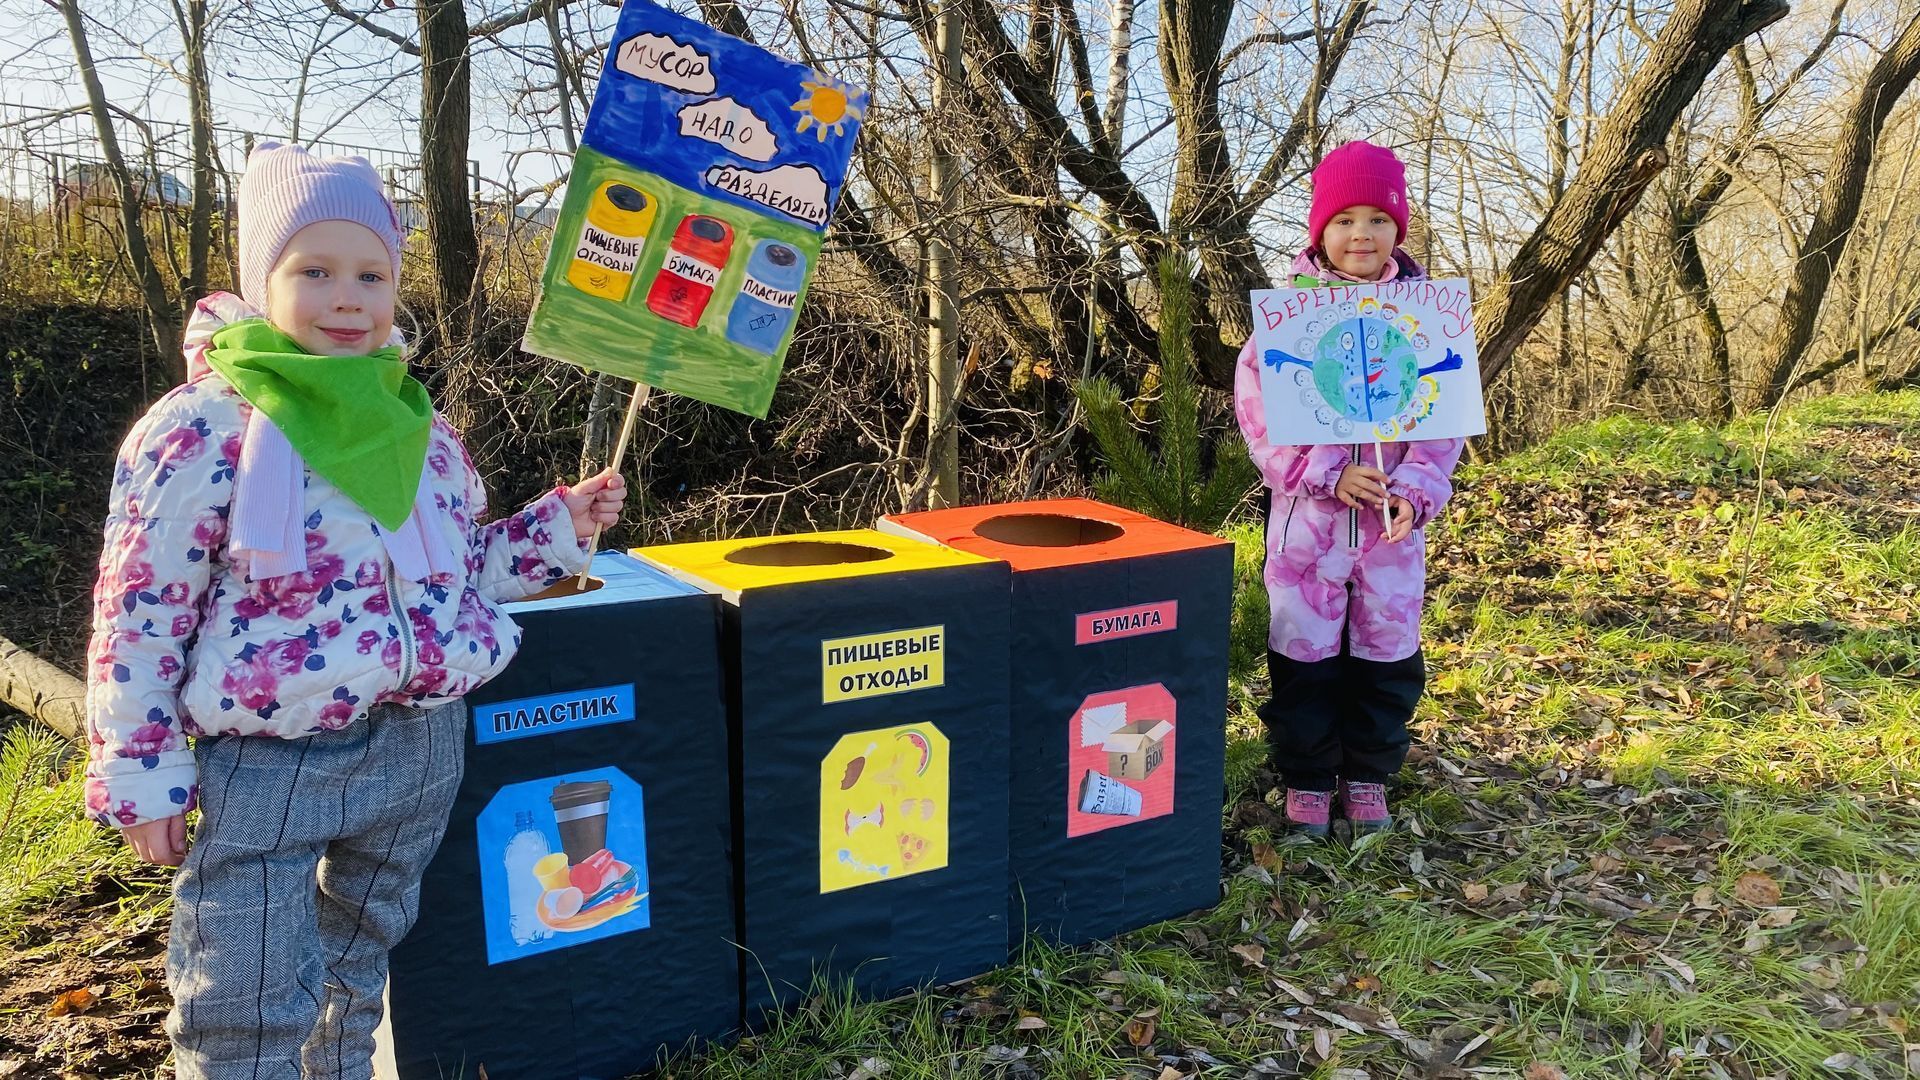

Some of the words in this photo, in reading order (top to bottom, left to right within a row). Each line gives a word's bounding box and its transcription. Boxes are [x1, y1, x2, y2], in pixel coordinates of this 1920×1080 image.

[626, 41, 705, 79] МУСОР
[691, 111, 753, 144] НАДО
[584, 227, 640, 257] ПИЩЕВЫЕ
[576, 248, 633, 272] ОТХОДЫ
[668, 255, 715, 283] БУМАГА
[743, 279, 797, 305] ПЛАСТИК
[1258, 285, 1360, 331] БЕРЕГИ
[1375, 282, 1474, 339] ПРИРОДУ
[1091, 610, 1163, 636] БУМАГА
[827, 634, 941, 667] ПИЩЕВЫЕ
[839, 664, 929, 693] ОТХОДЫ
[493, 694, 620, 733] ПЛАСТИК
[1120, 754, 1128, 776] ?
[1145, 748, 1164, 773] BOX
